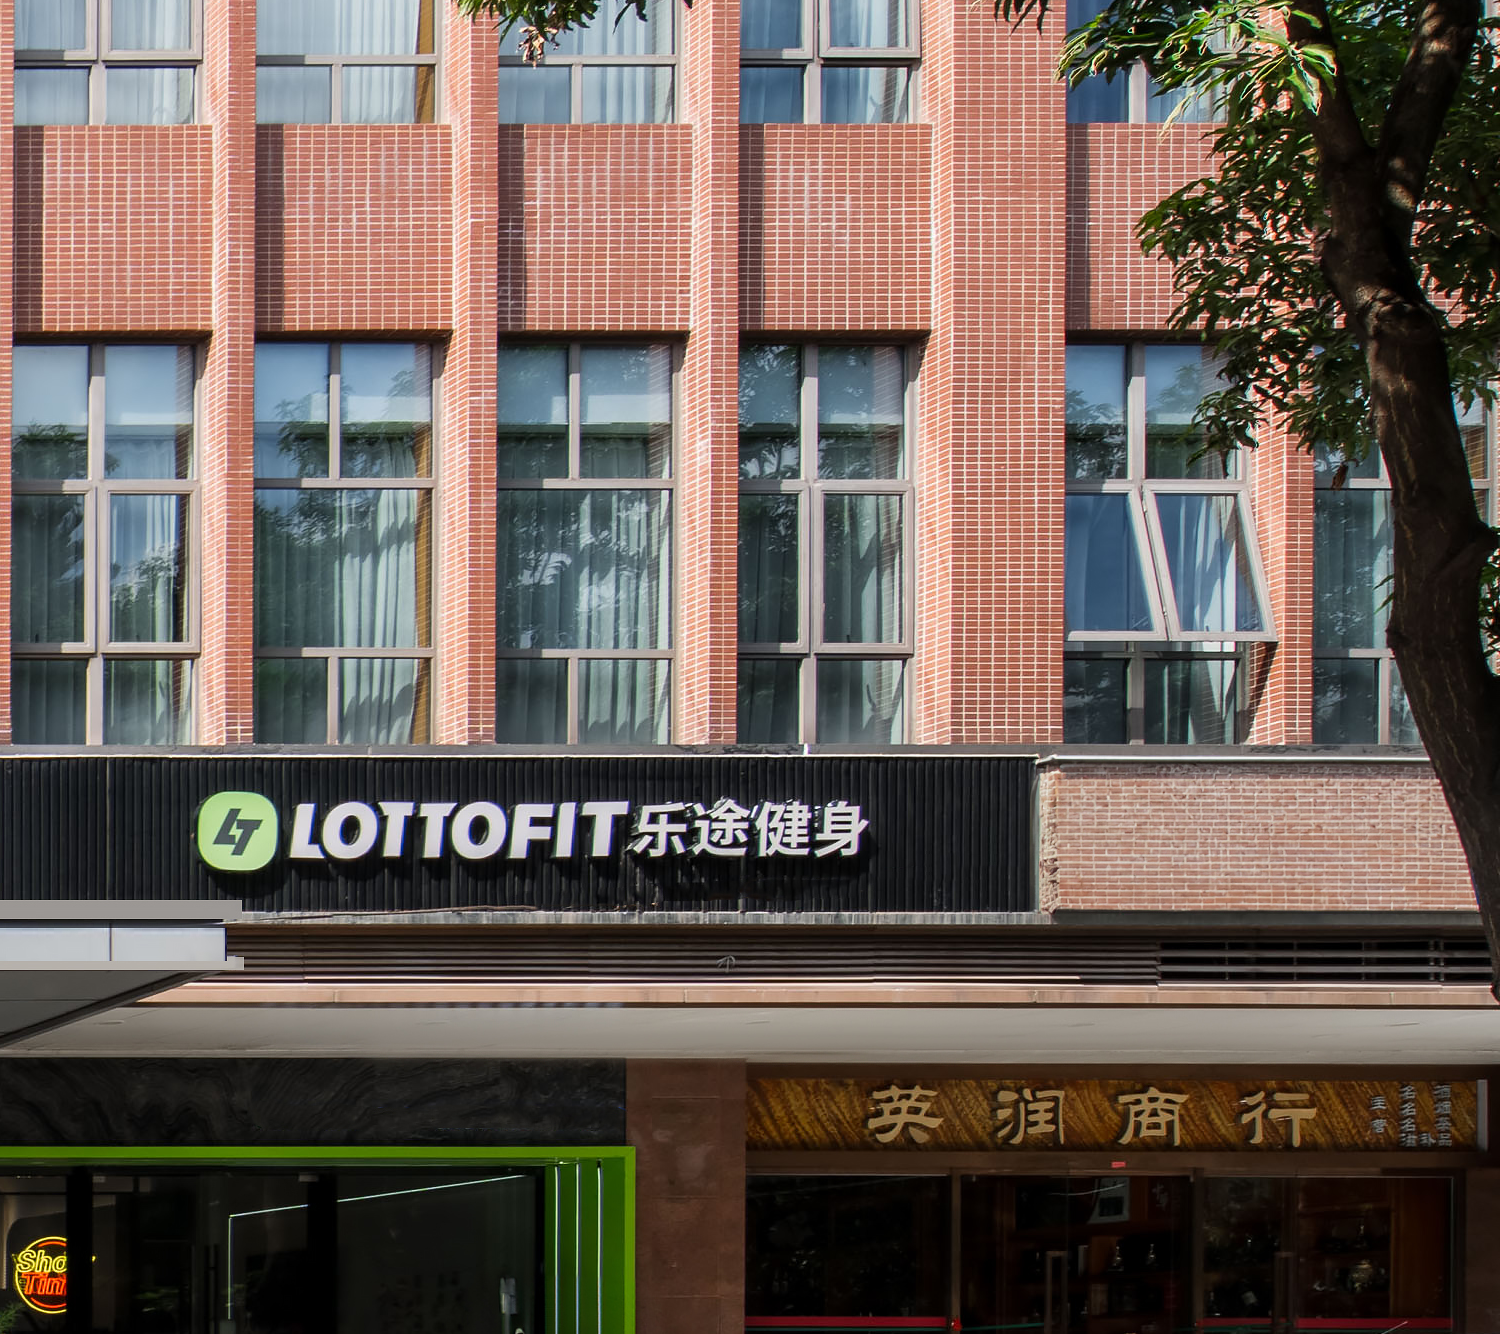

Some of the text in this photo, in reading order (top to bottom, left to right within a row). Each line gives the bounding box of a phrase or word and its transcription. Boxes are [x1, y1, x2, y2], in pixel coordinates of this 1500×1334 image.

[289, 797, 869, 860] LOTTOFIT 乐途健身
[867, 1084, 1318, 1147] 英润商行
[16, 1249, 68, 1274] Sho
